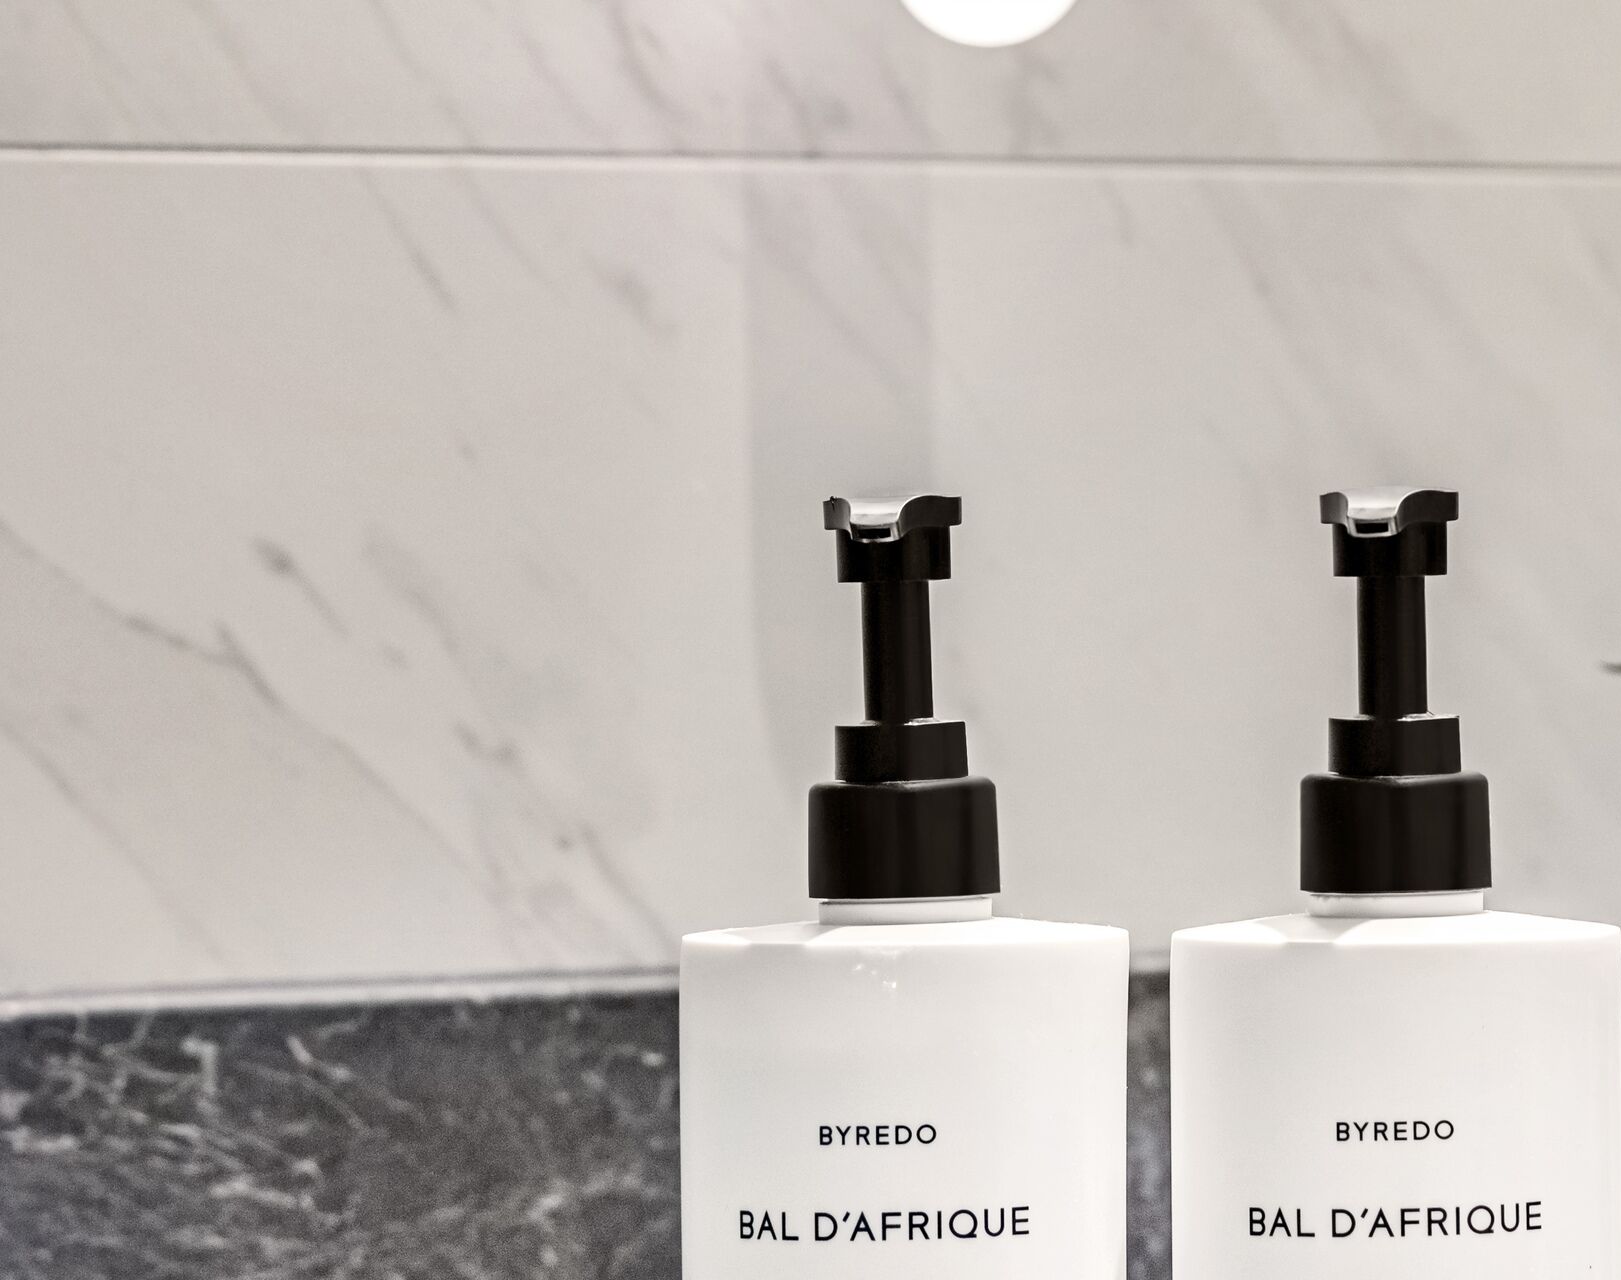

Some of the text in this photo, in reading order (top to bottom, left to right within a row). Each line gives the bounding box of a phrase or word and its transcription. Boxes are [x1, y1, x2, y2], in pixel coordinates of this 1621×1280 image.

[819, 1123, 937, 1146] BYREDO
[1336, 1118, 1455, 1142] BYREDO
[739, 1205, 1030, 1242] BAL D'AFRIQUE
[1249, 1200, 1542, 1238] BAL D'AFRIQUE
